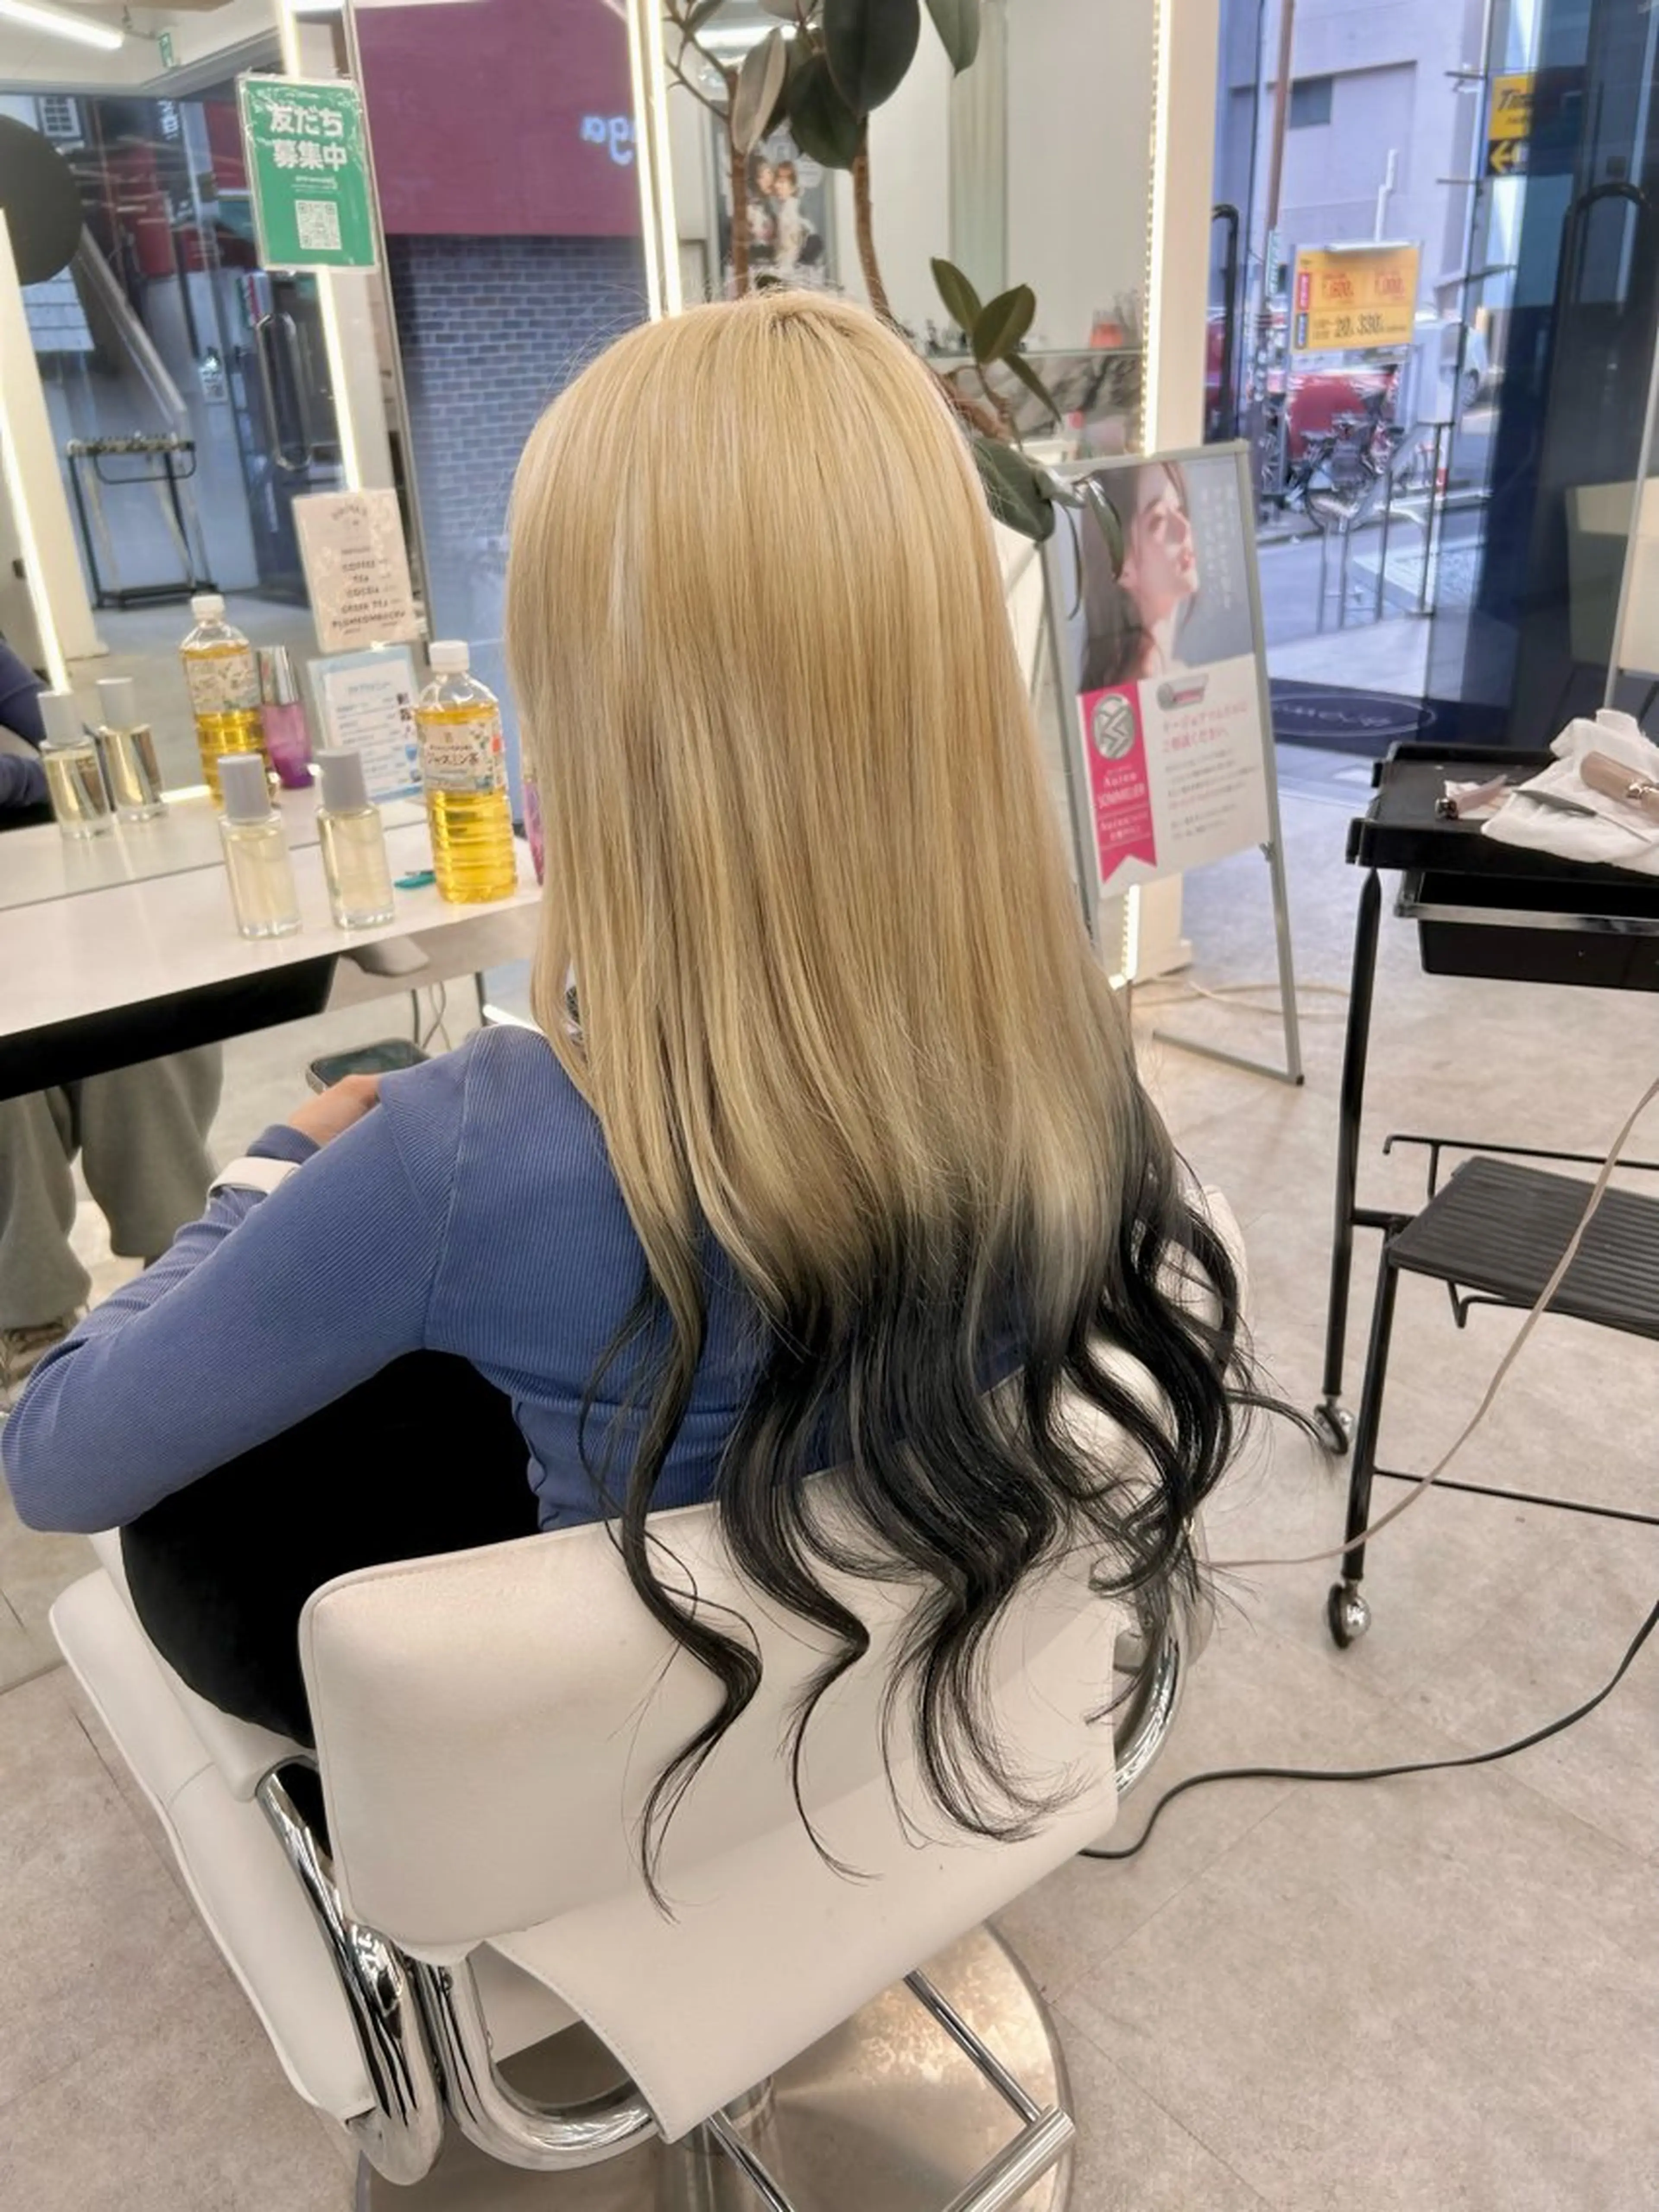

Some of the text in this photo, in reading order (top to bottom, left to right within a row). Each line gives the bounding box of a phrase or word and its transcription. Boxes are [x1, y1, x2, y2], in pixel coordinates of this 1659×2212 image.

[270, 103, 344, 137] 友だち
[273, 140, 347, 171] 募集中
